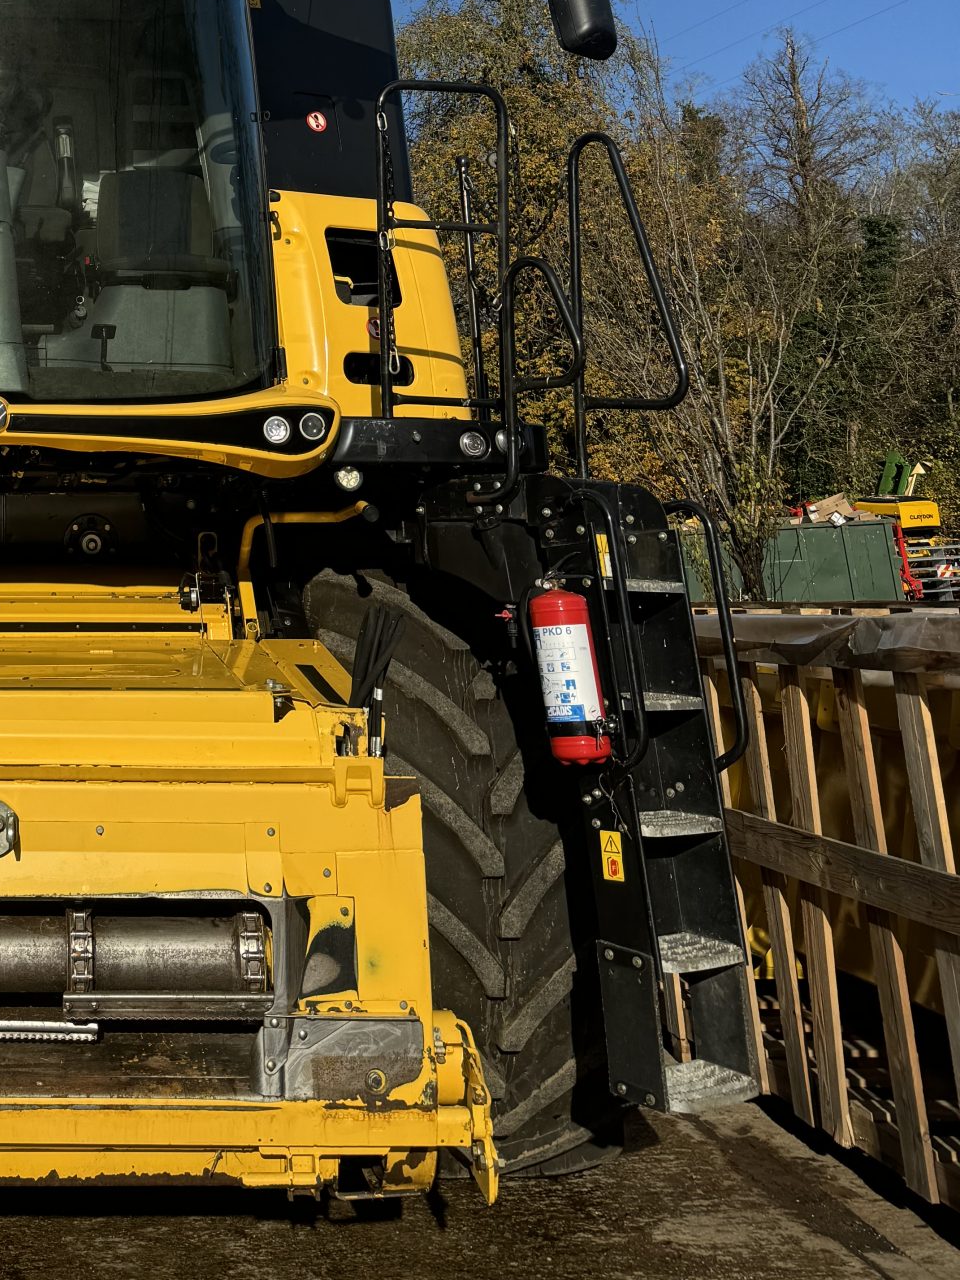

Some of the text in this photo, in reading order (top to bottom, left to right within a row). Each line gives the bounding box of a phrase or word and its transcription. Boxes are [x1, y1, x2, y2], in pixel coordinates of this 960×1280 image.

[909, 513, 934, 523] CLAYDON
[542, 626, 572, 637] PKD 6
